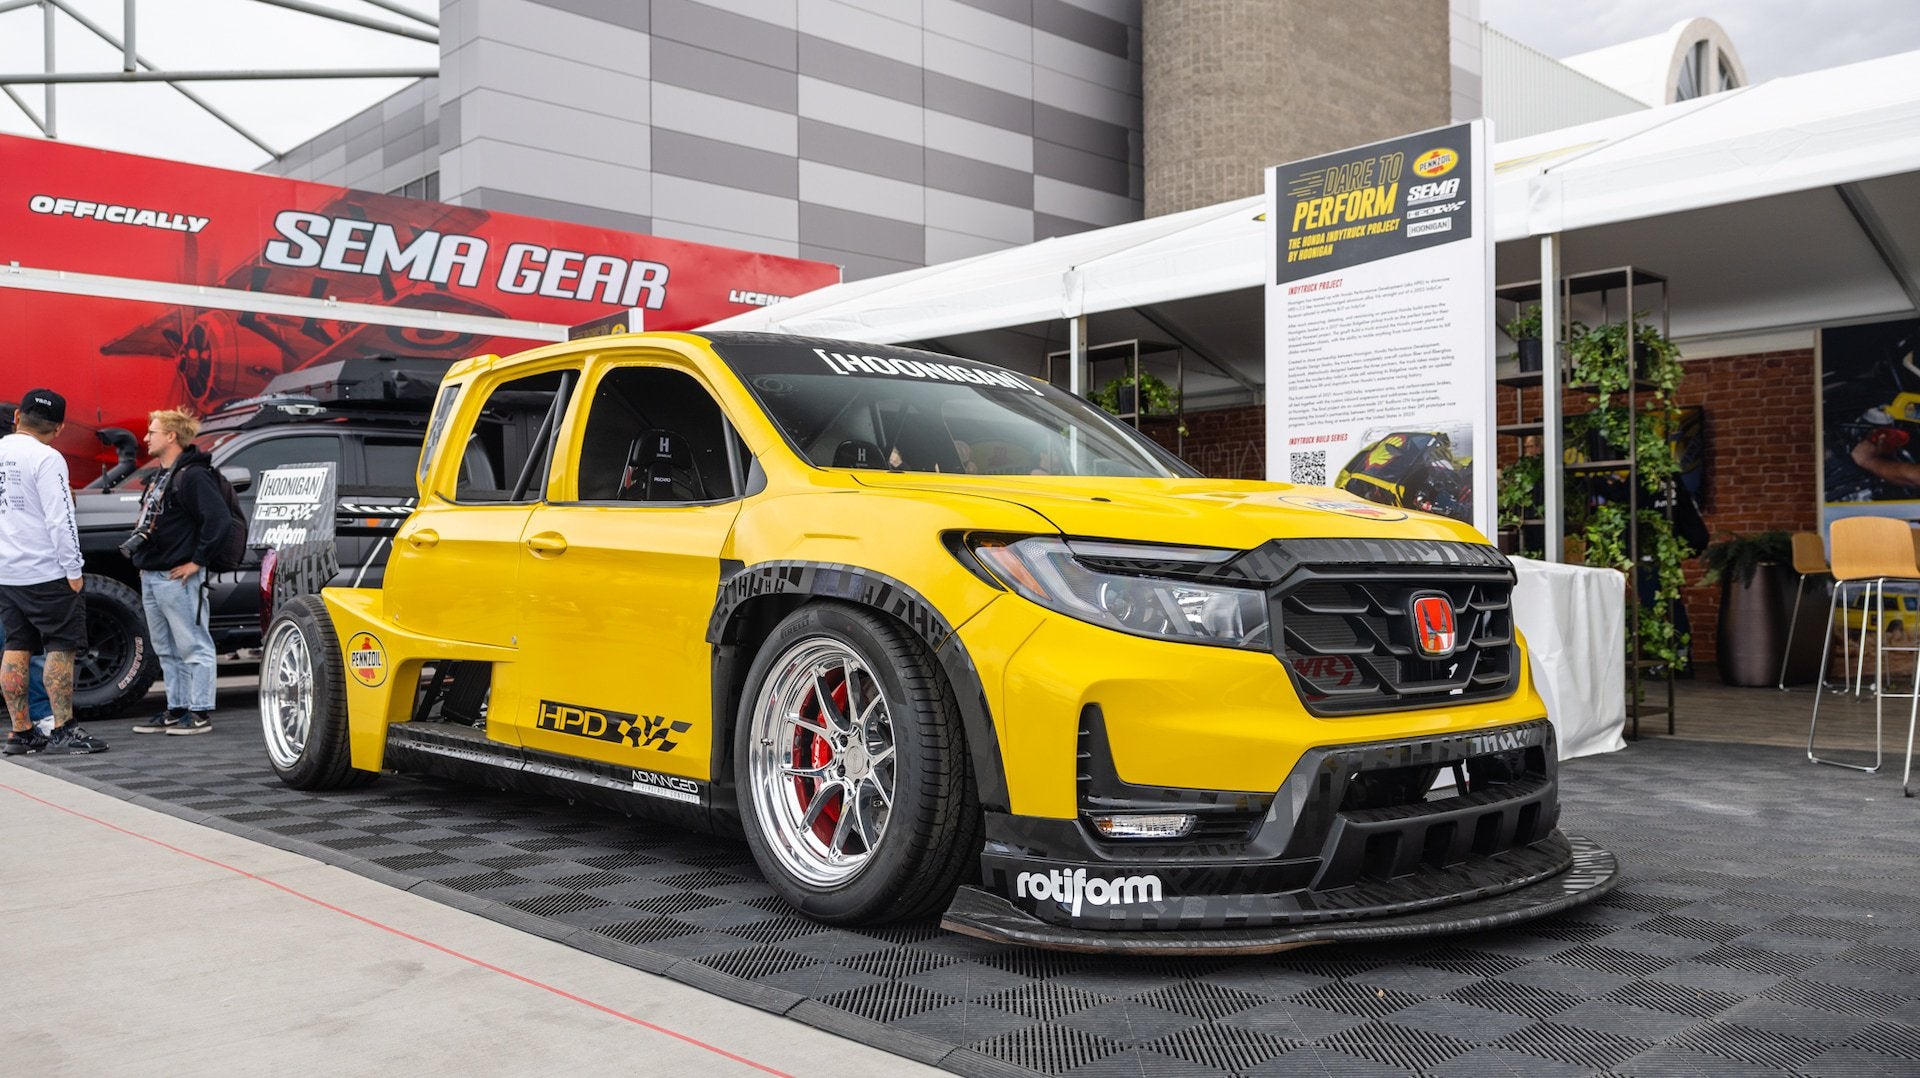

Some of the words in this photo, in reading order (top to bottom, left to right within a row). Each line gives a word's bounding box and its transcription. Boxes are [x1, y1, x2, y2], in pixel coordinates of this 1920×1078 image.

[1323, 159, 1376, 196] DARE
[1378, 151, 1404, 184] TO
[1418, 155, 1452, 171] PENNZOIL
[1407, 178, 1460, 201] SEMA
[29, 194, 210, 233] OFFICIALLY
[1292, 182, 1398, 232] PERFORM
[1288, 236, 1302, 249] THE
[1302, 233, 1327, 248] HONDA
[1326, 225, 1367, 244] INDYTRUCK
[1366, 218, 1401, 235] PROJECT
[265, 210, 489, 288] SEMA
[497, 242, 670, 310] GEAR
[1288, 249, 1298, 263] BY
[1298, 244, 1334, 260] HOONIGAN
[1288, 283, 1318, 295] INDYTRUCK
[1319, 278, 1344, 290] PROJECT
[659, 437, 669, 452] H
[1288, 436, 1315, 446] INDYTRUCK
[1316, 435, 1331, 444] BUILD
[1331, 433, 1349, 442] SERIES
[258, 506, 288, 517] HPD
[262, 524, 306, 551] rotiform
[352, 651, 382, 667] PENNZOIL
[538, 703, 608, 737] HPD
[631, 769, 699, 794] ADVANCED
[1016, 868, 1163, 918] rotiform
